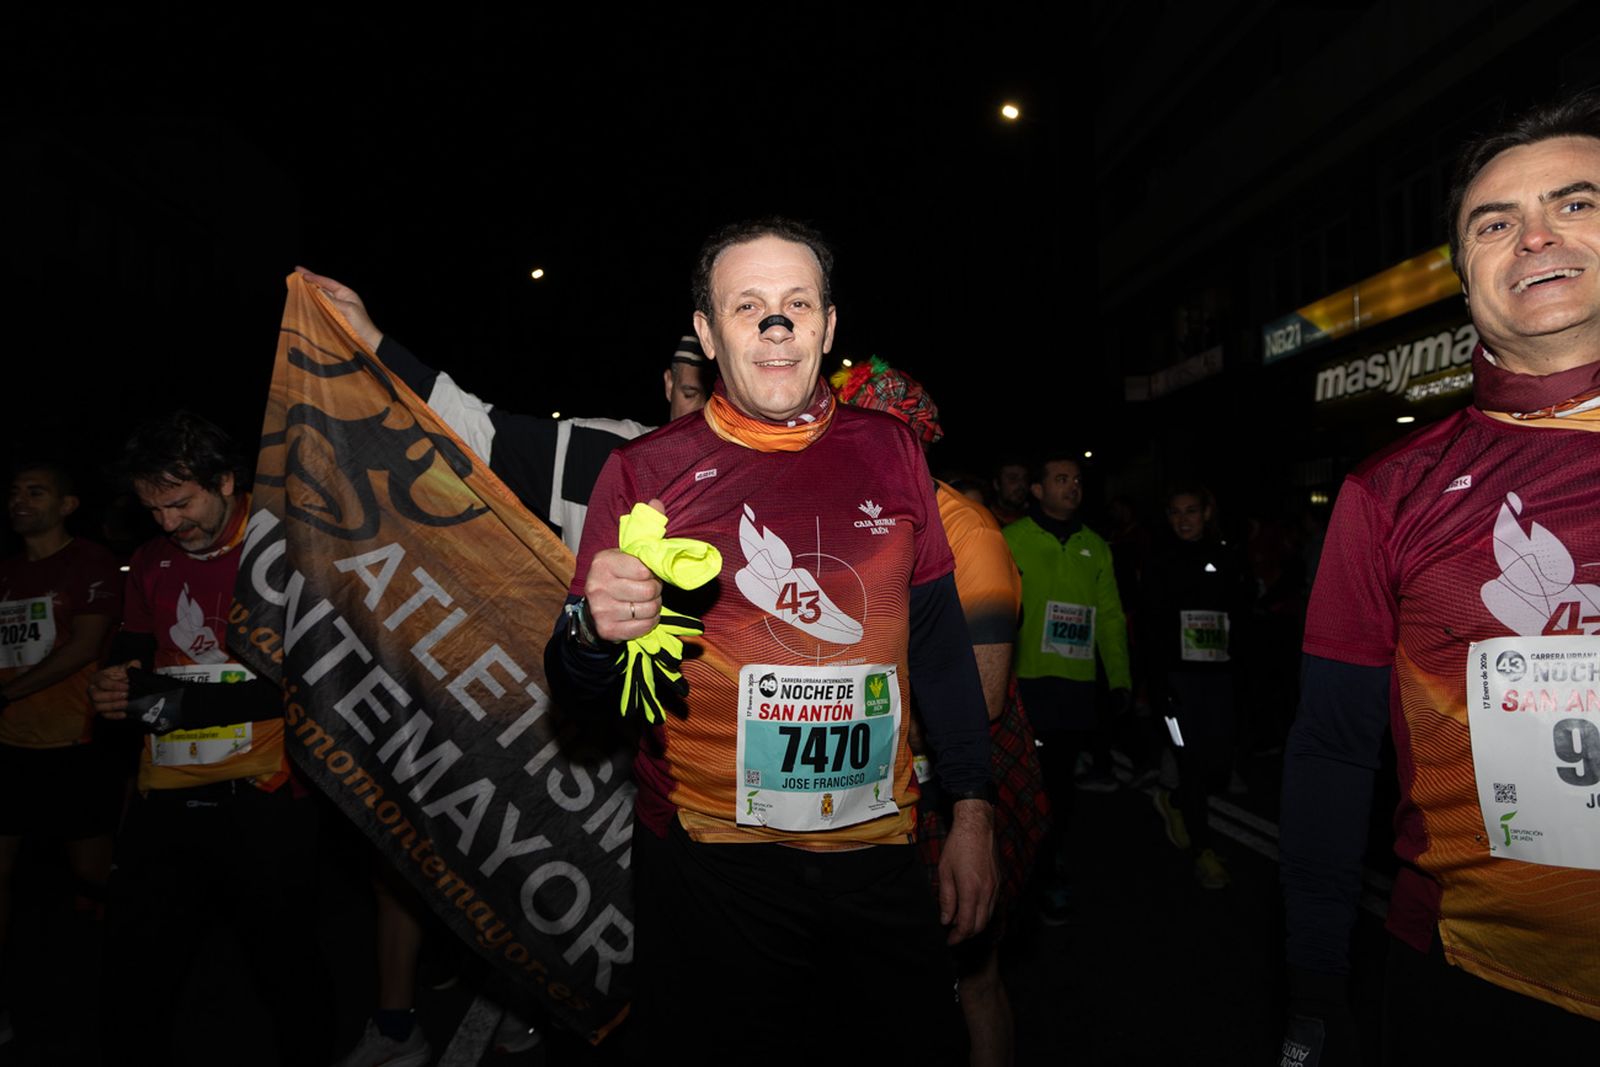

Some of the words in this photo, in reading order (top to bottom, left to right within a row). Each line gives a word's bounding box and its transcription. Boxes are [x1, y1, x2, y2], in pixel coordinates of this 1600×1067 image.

[775, 582, 822, 624] 43
[1, 622, 40, 645] 2024
[1482, 667, 1488, 679] de
[780, 684, 834, 700] NOCHE
[836, 684, 854, 699] DE
[1482, 680, 1490, 701] Enero
[1502, 689, 1557, 712] SAN
[758, 703, 795, 721] SAN
[797, 700, 854, 721] ANTÓN
[1483, 702, 1491, 710] 17
[778, 722, 871, 773] 7470
[782, 777, 810, 790] JOSE
[813, 772, 865, 789] FRANCISCO
